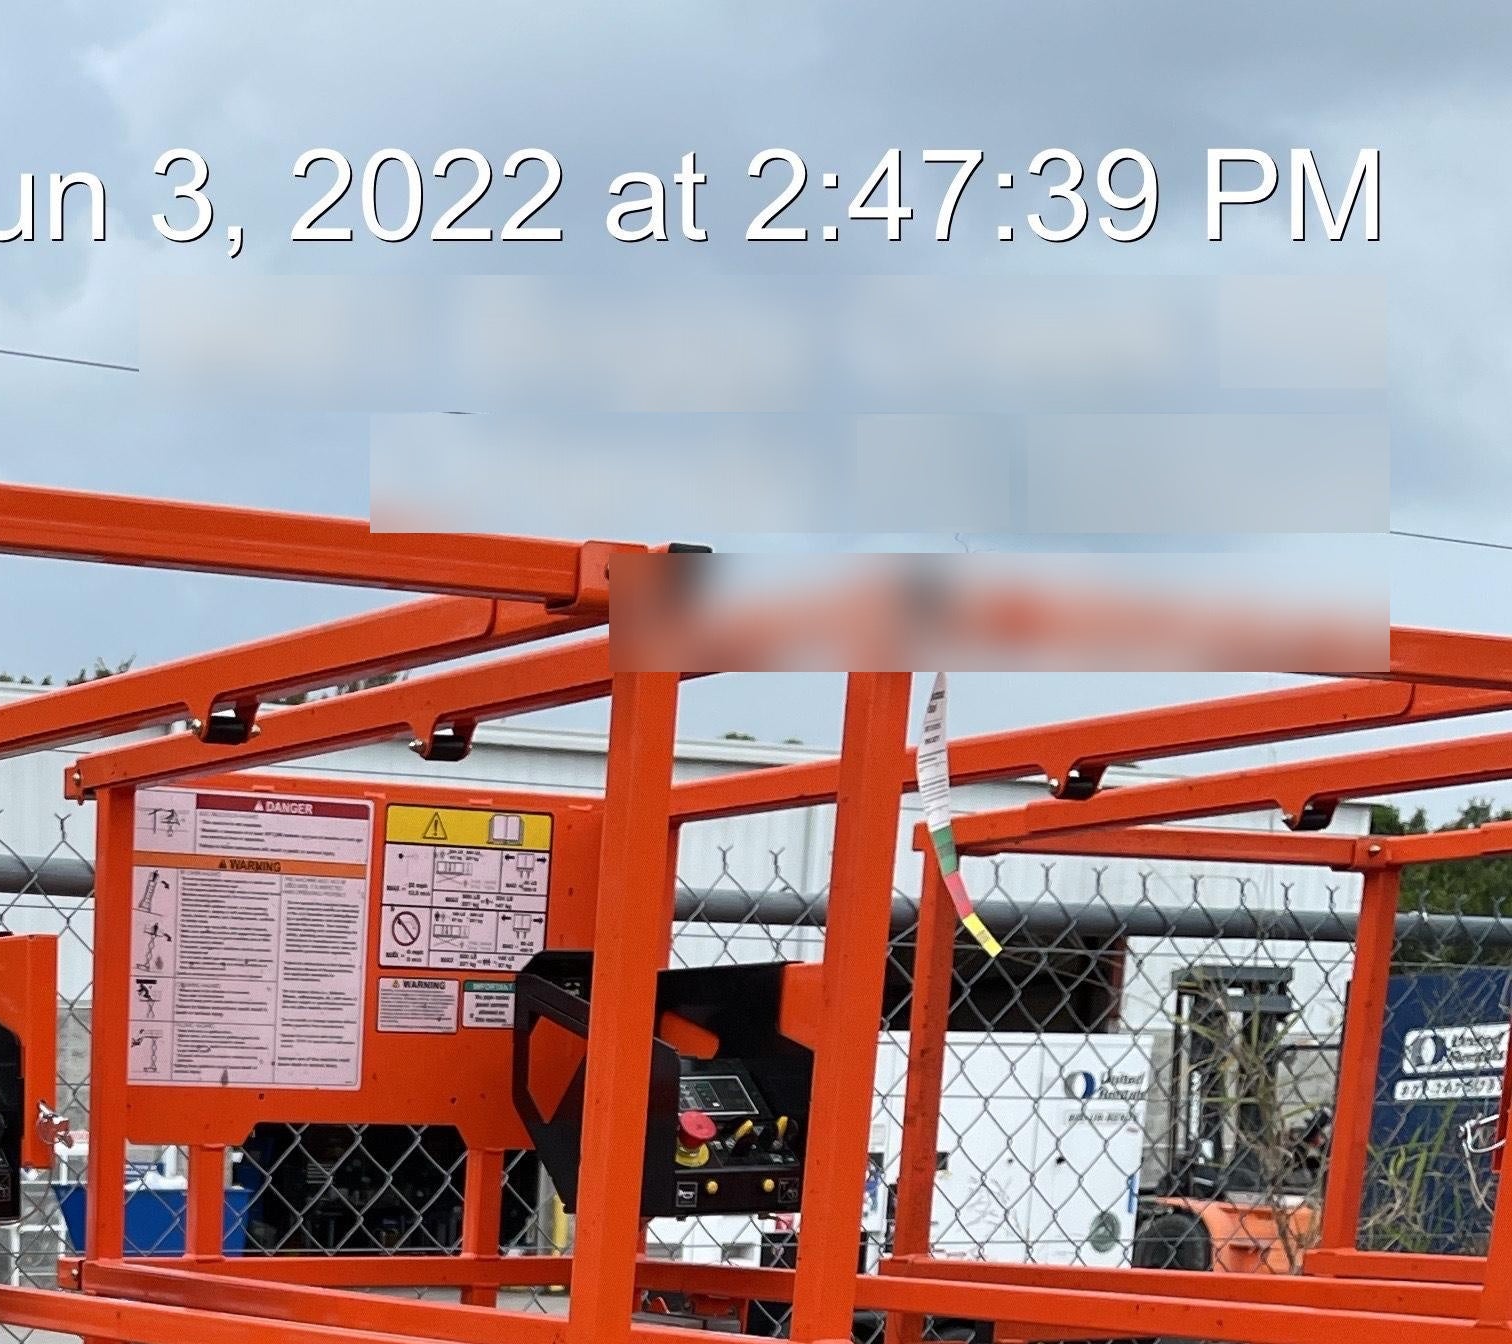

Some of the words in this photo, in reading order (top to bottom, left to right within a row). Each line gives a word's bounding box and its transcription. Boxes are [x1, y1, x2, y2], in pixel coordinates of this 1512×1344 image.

[266, 802, 313, 815] DANGER
[230, 859, 281, 873] WARNING
[403, 980, 446, 990] WARNING
